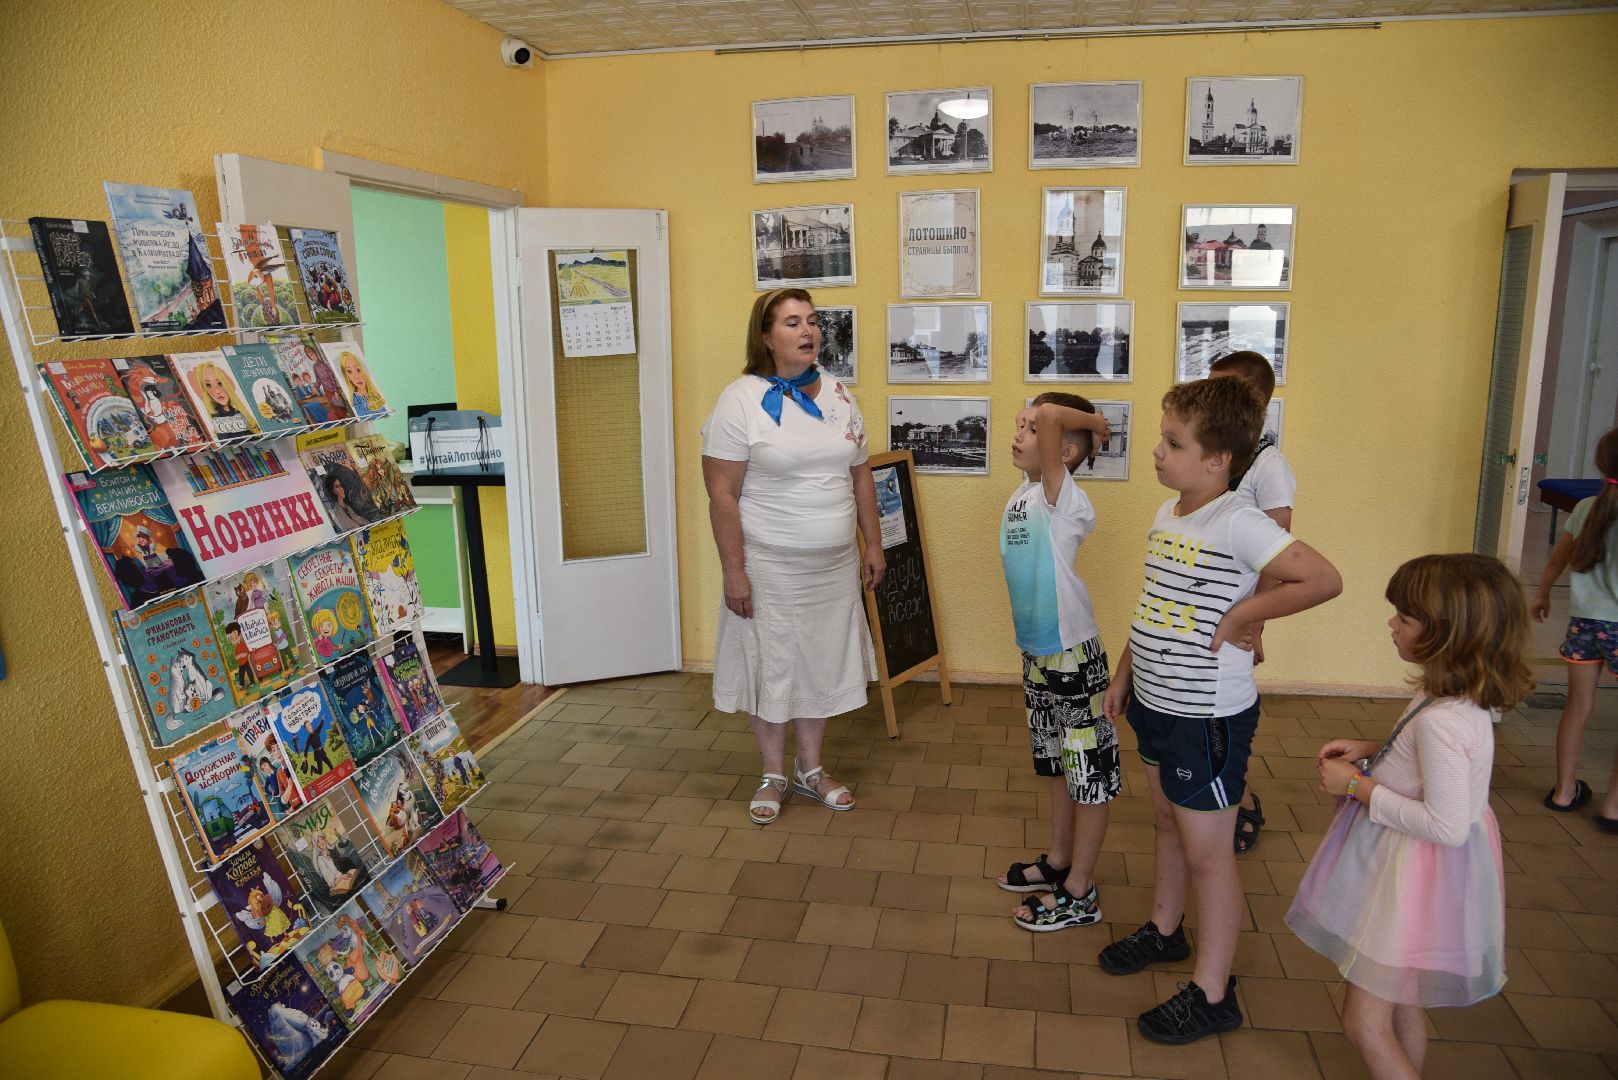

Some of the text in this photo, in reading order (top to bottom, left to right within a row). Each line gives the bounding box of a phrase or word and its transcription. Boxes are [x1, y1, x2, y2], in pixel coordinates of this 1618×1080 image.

[908, 226, 967, 241] ЛОТОШИНО
[908, 246, 941, 256] СТРАНИЦЫ
[242, 356, 268, 368] ДЕТИ
[95, 490, 161, 515] ВЕЖЛИВОСТИ
[297, 550, 333, 580] СЕКРЕТНЫЕ
[314, 562, 345, 581] СЕКРЕТЫ
[306, 575, 356, 602] ЖИВОТА МАШИ
[145, 613, 192, 637] ФИНАНСОВАЯ
[146, 622, 196, 647] ГРАМОТНОСТЬ
[184, 751, 237, 786] Дорожные
[199, 762, 243, 791] истории
[227, 850, 252, 869] Зачем
